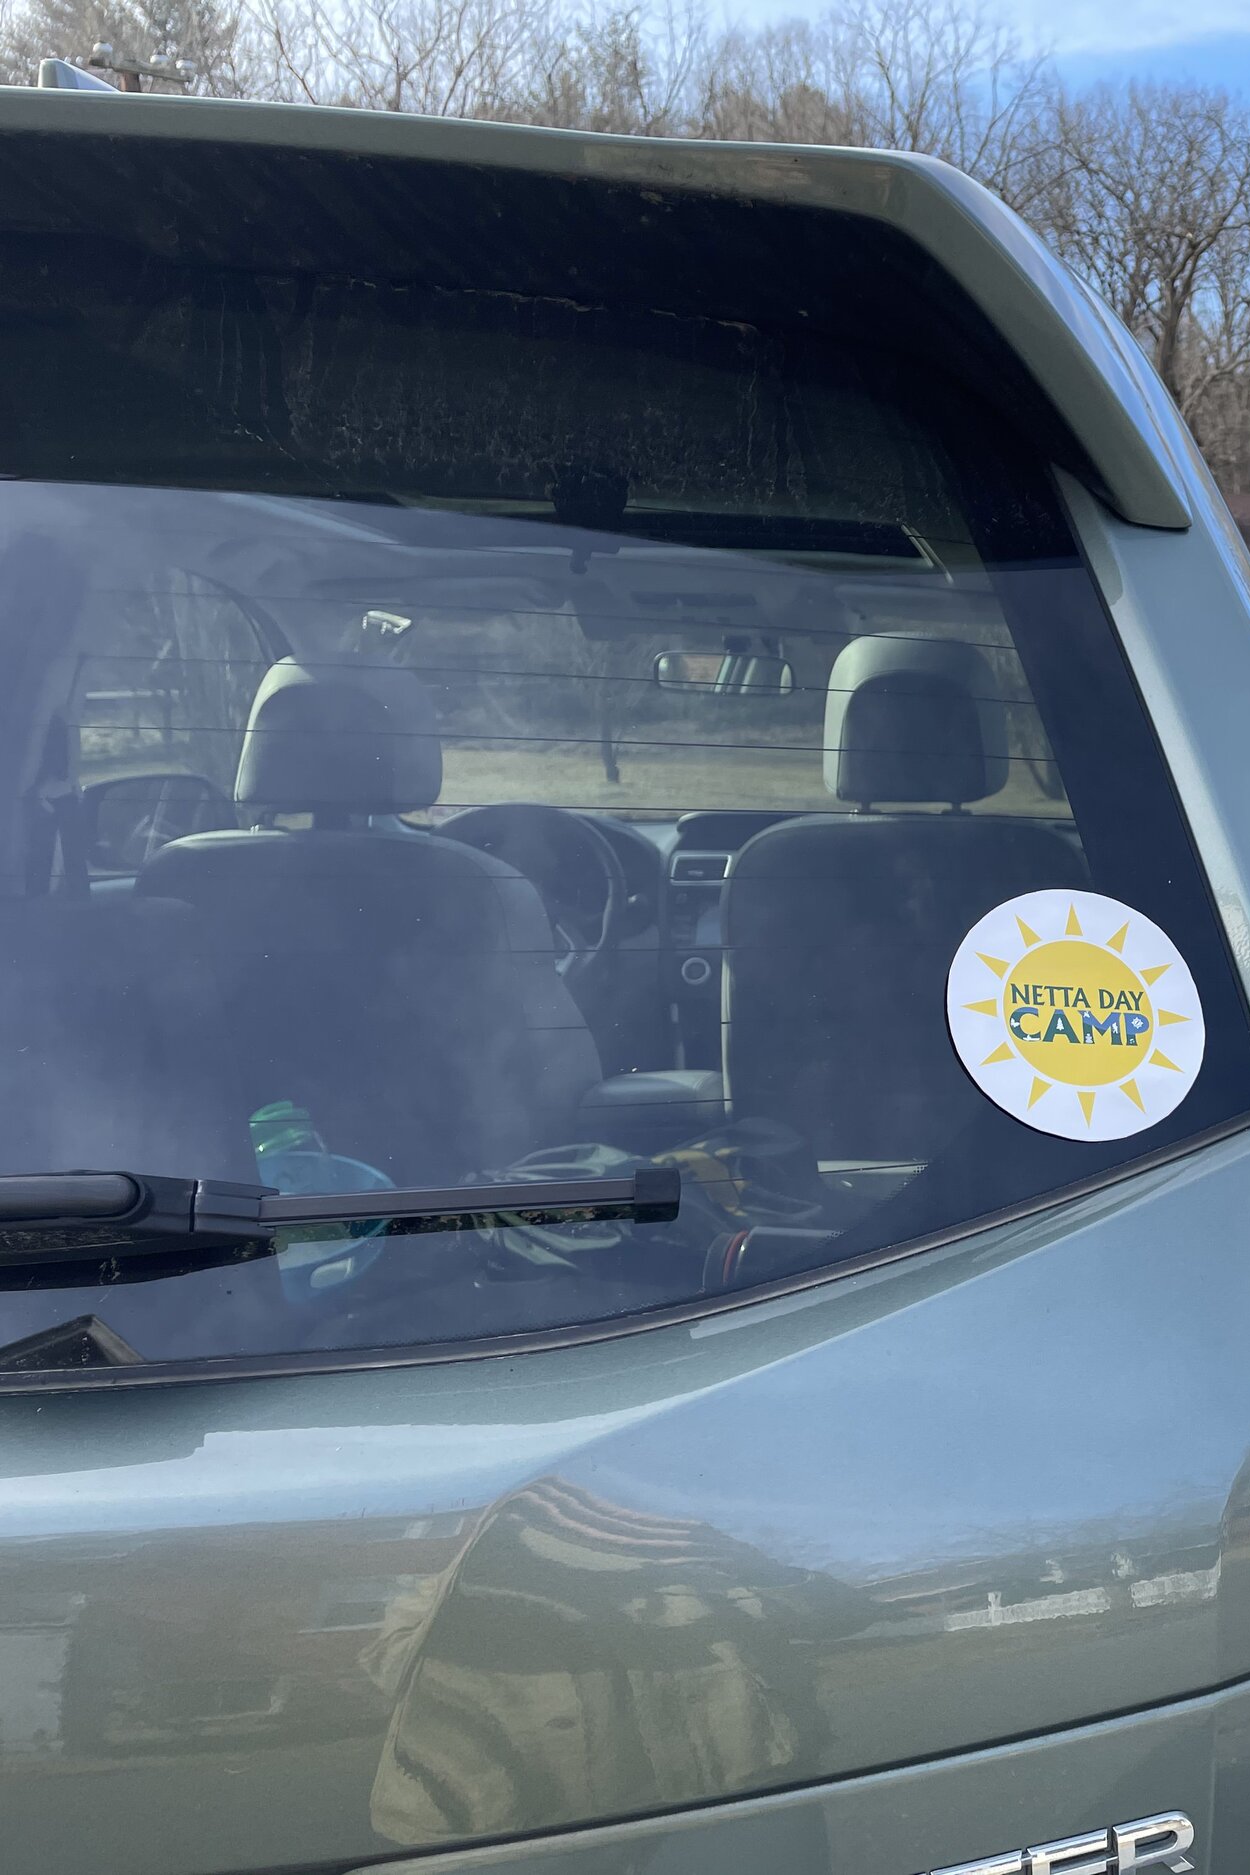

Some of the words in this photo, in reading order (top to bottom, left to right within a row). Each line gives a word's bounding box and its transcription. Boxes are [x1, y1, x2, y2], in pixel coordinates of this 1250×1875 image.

[1010, 983, 1091, 1008] NETTA
[1098, 988, 1144, 1011] DAY
[1009, 1006, 1150, 1046] CAMP
